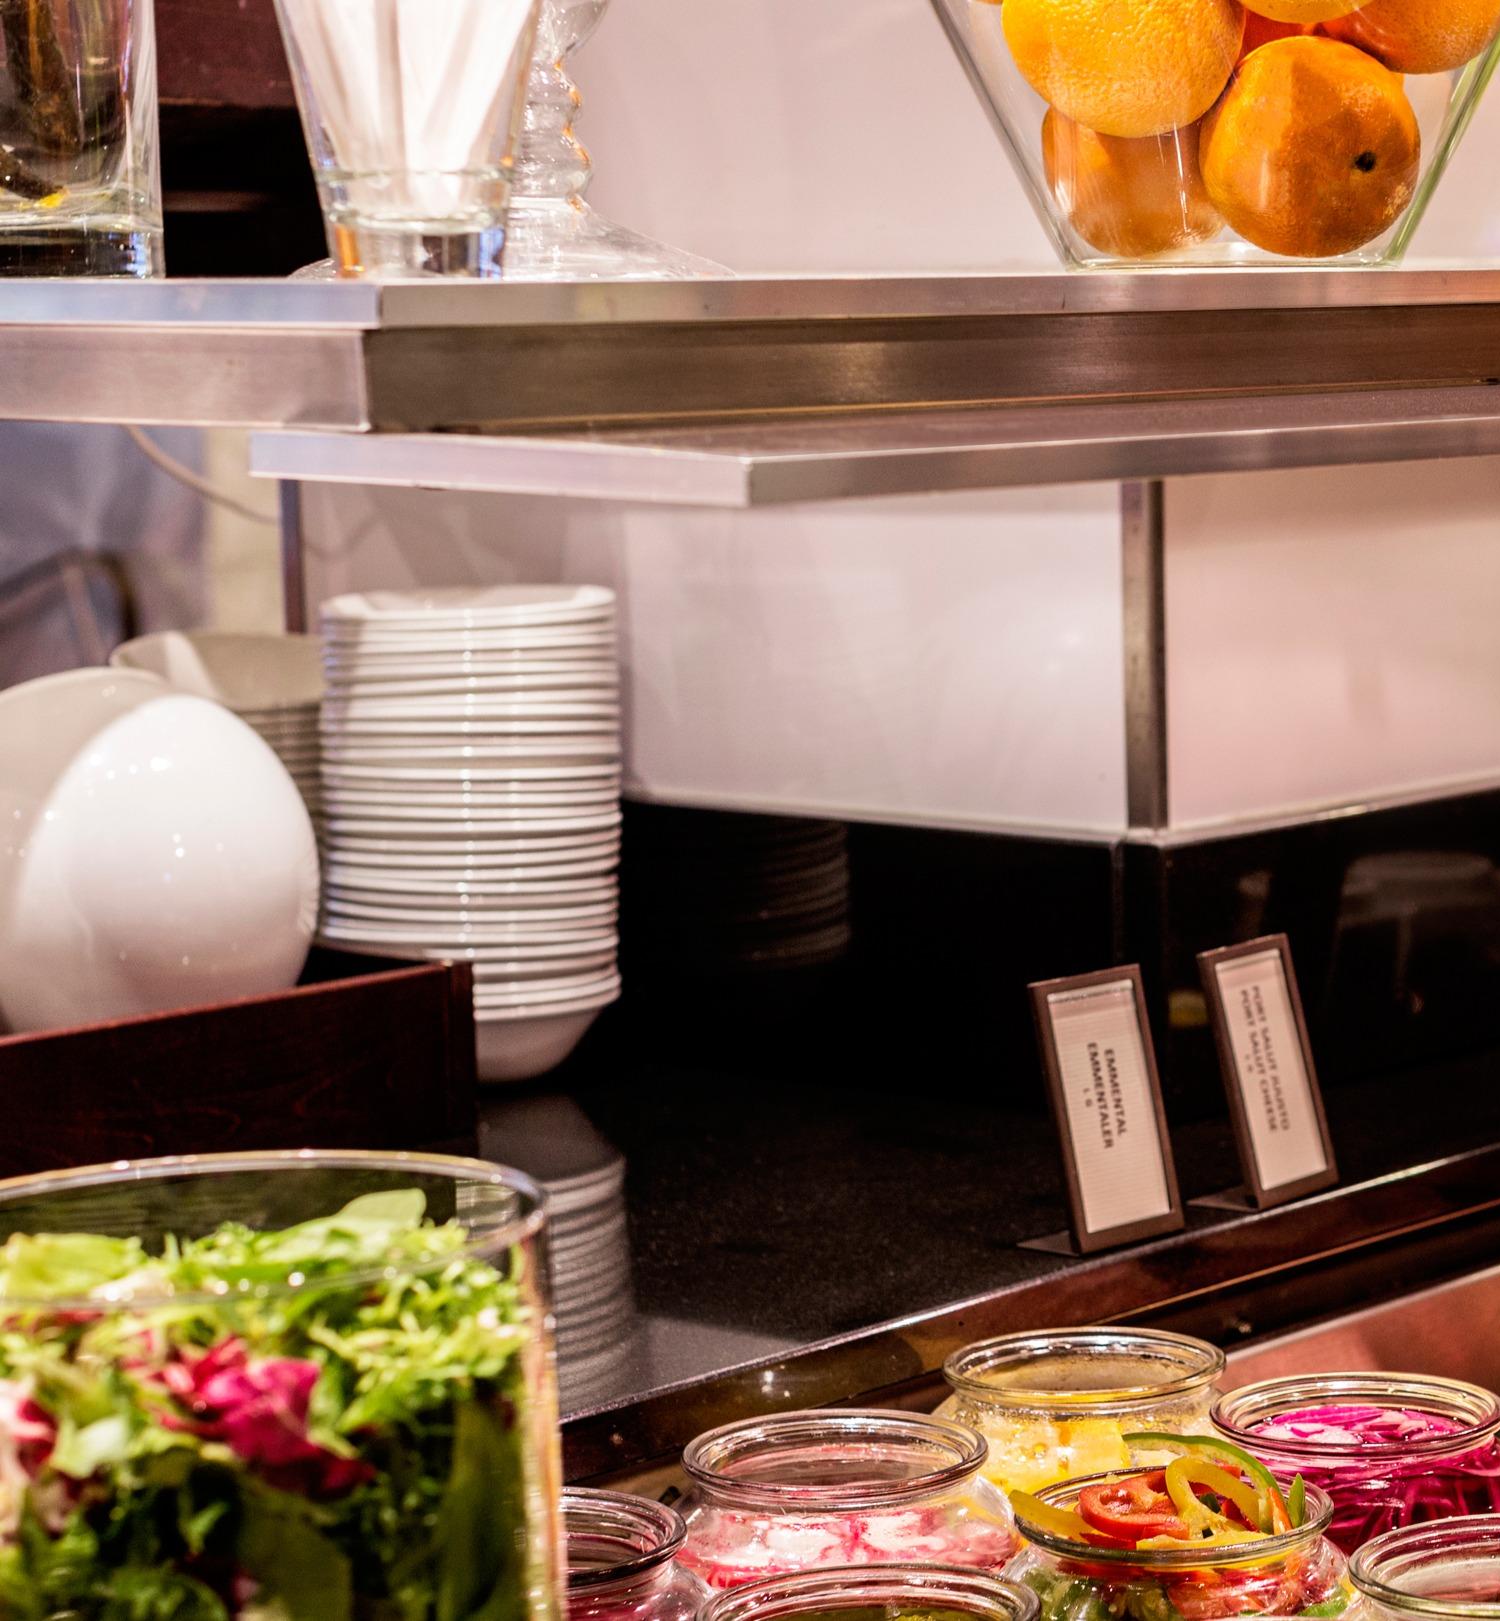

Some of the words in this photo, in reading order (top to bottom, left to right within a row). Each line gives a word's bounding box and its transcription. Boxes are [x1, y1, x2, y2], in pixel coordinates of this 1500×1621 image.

[1086, 1042, 1115, 1149] EMMENTALER
[1103, 1048, 1128, 1137] EMMENTAL
[1240, 989, 1255, 1027] PORT
[1249, 1031, 1266, 1075] SALUT
[1259, 1079, 1277, 1132] CHEESE
[1252, 985, 1267, 1022] PORT
[1260, 1026, 1278, 1072] SALUT
[1270, 1075, 1291, 1131] JUUSTO
